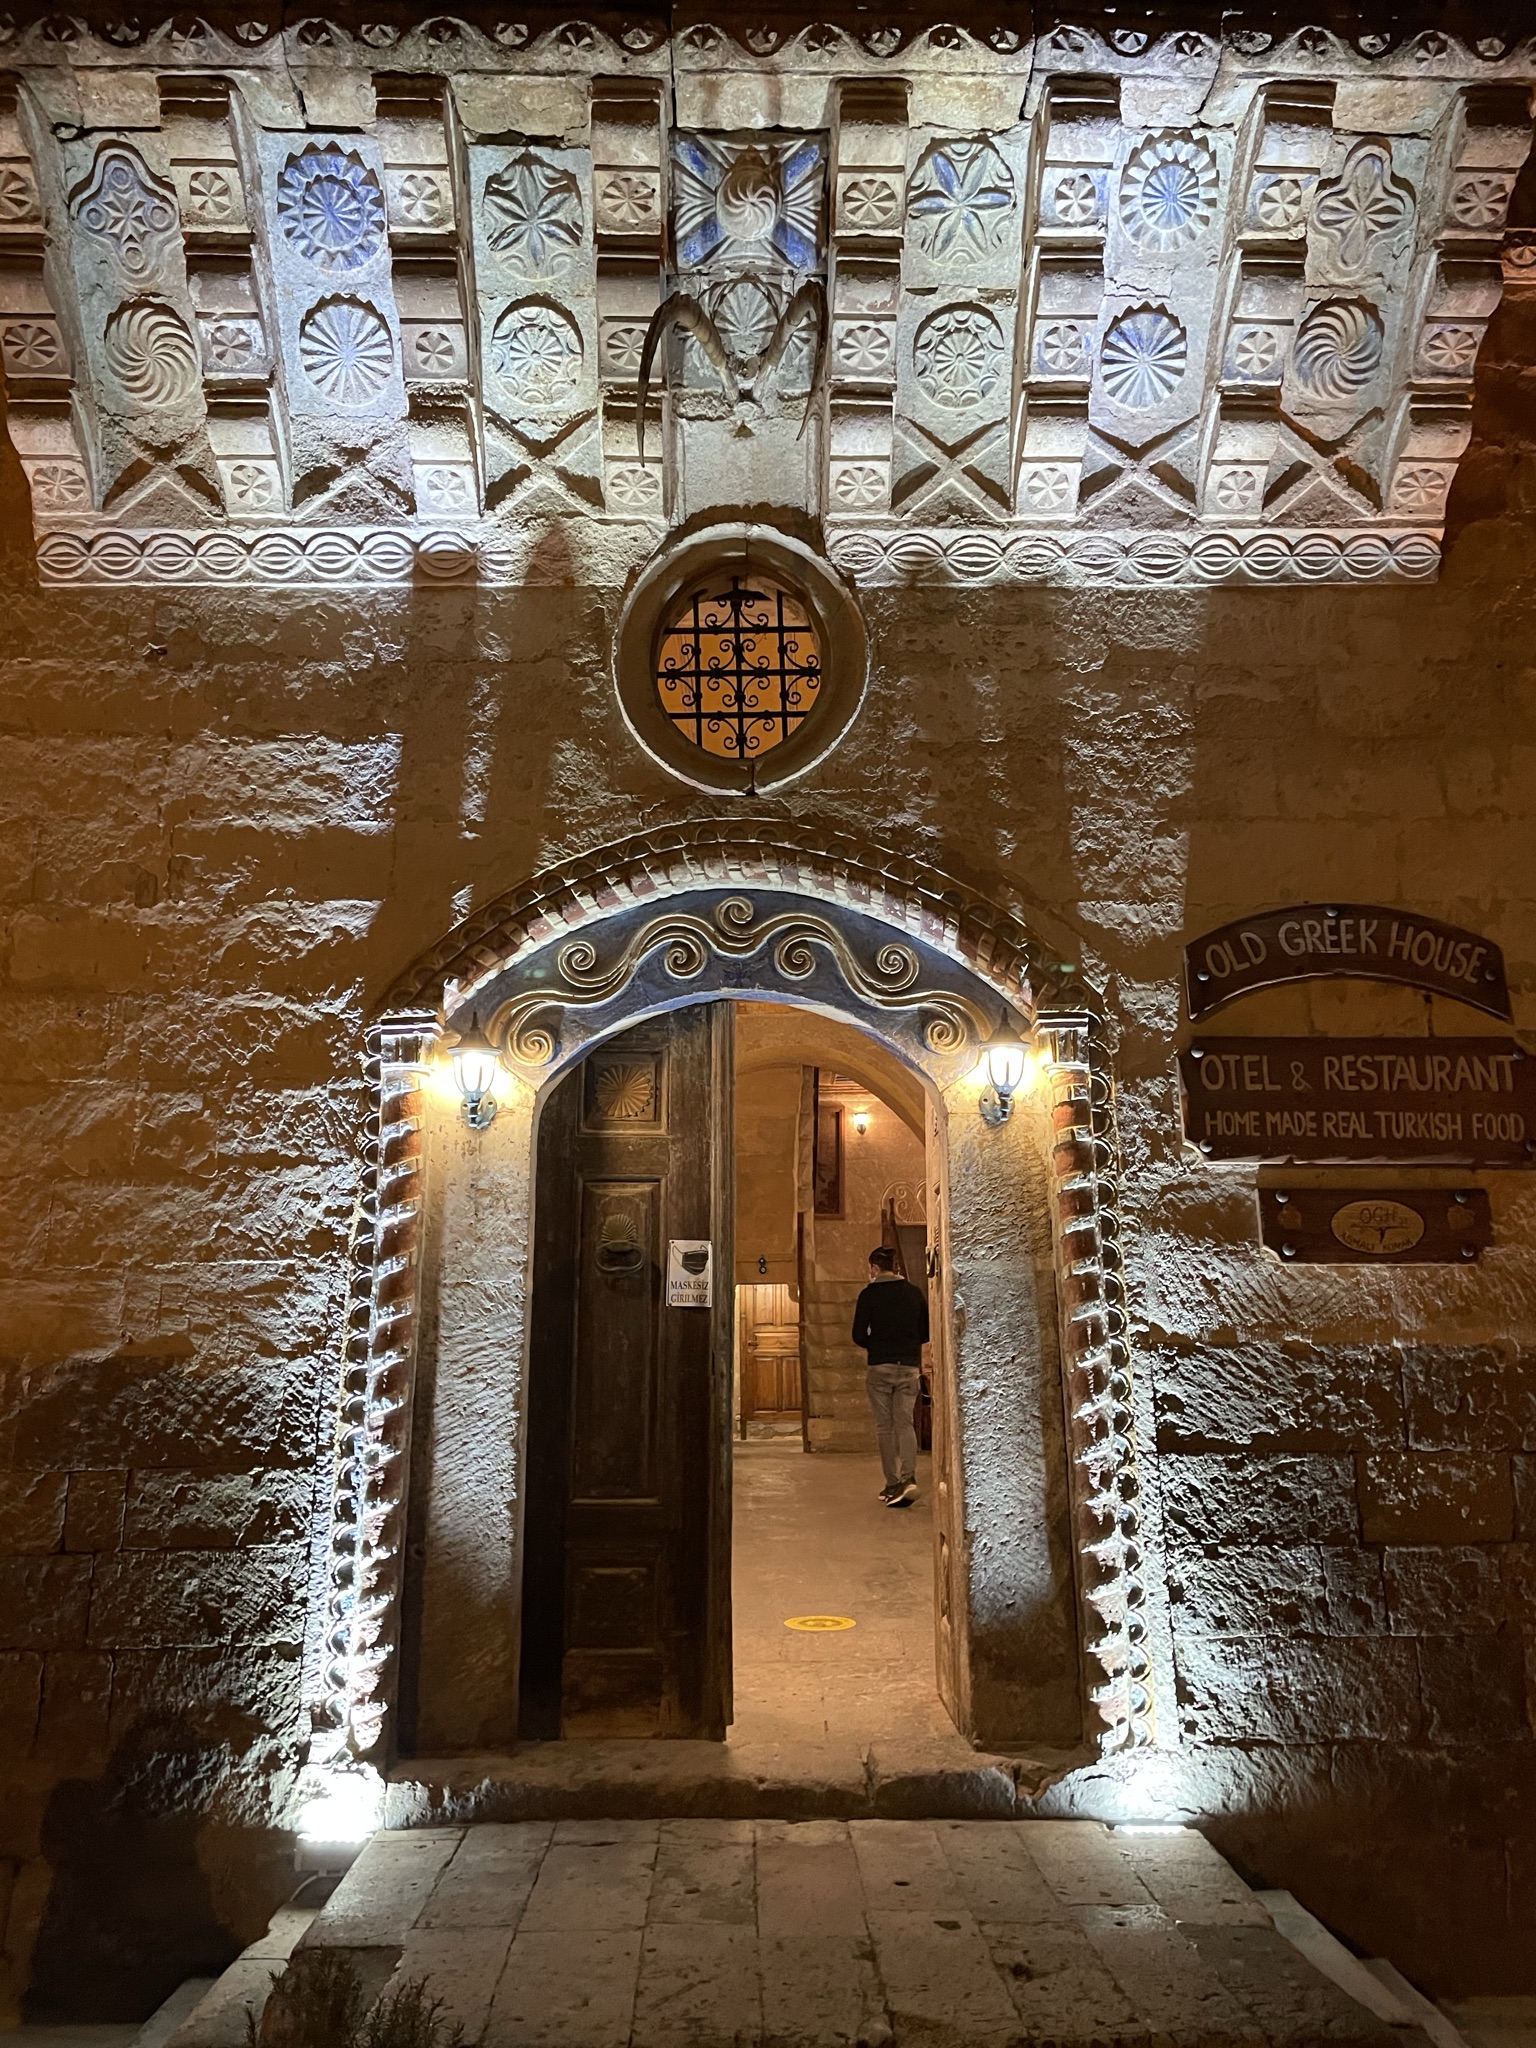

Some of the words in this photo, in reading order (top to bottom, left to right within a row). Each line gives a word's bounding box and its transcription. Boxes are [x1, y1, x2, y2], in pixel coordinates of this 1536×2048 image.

[1205, 932, 1267, 978] OLD
[1278, 919, 1378, 956] GREEK
[1387, 921, 1487, 984] HOUSE
[1200, 1055, 1282, 1091] OTEL
[1290, 1061, 1313, 1090] &
[1323, 1055, 1515, 1092] RESTAURANT
[1205, 1110, 1261, 1137] HOME
[1265, 1111, 1317, 1137] MADE
[1323, 1111, 1373, 1138] REAL
[1374, 1111, 1463, 1140] TURKISH
[1472, 1113, 1525, 1142] FOOD
